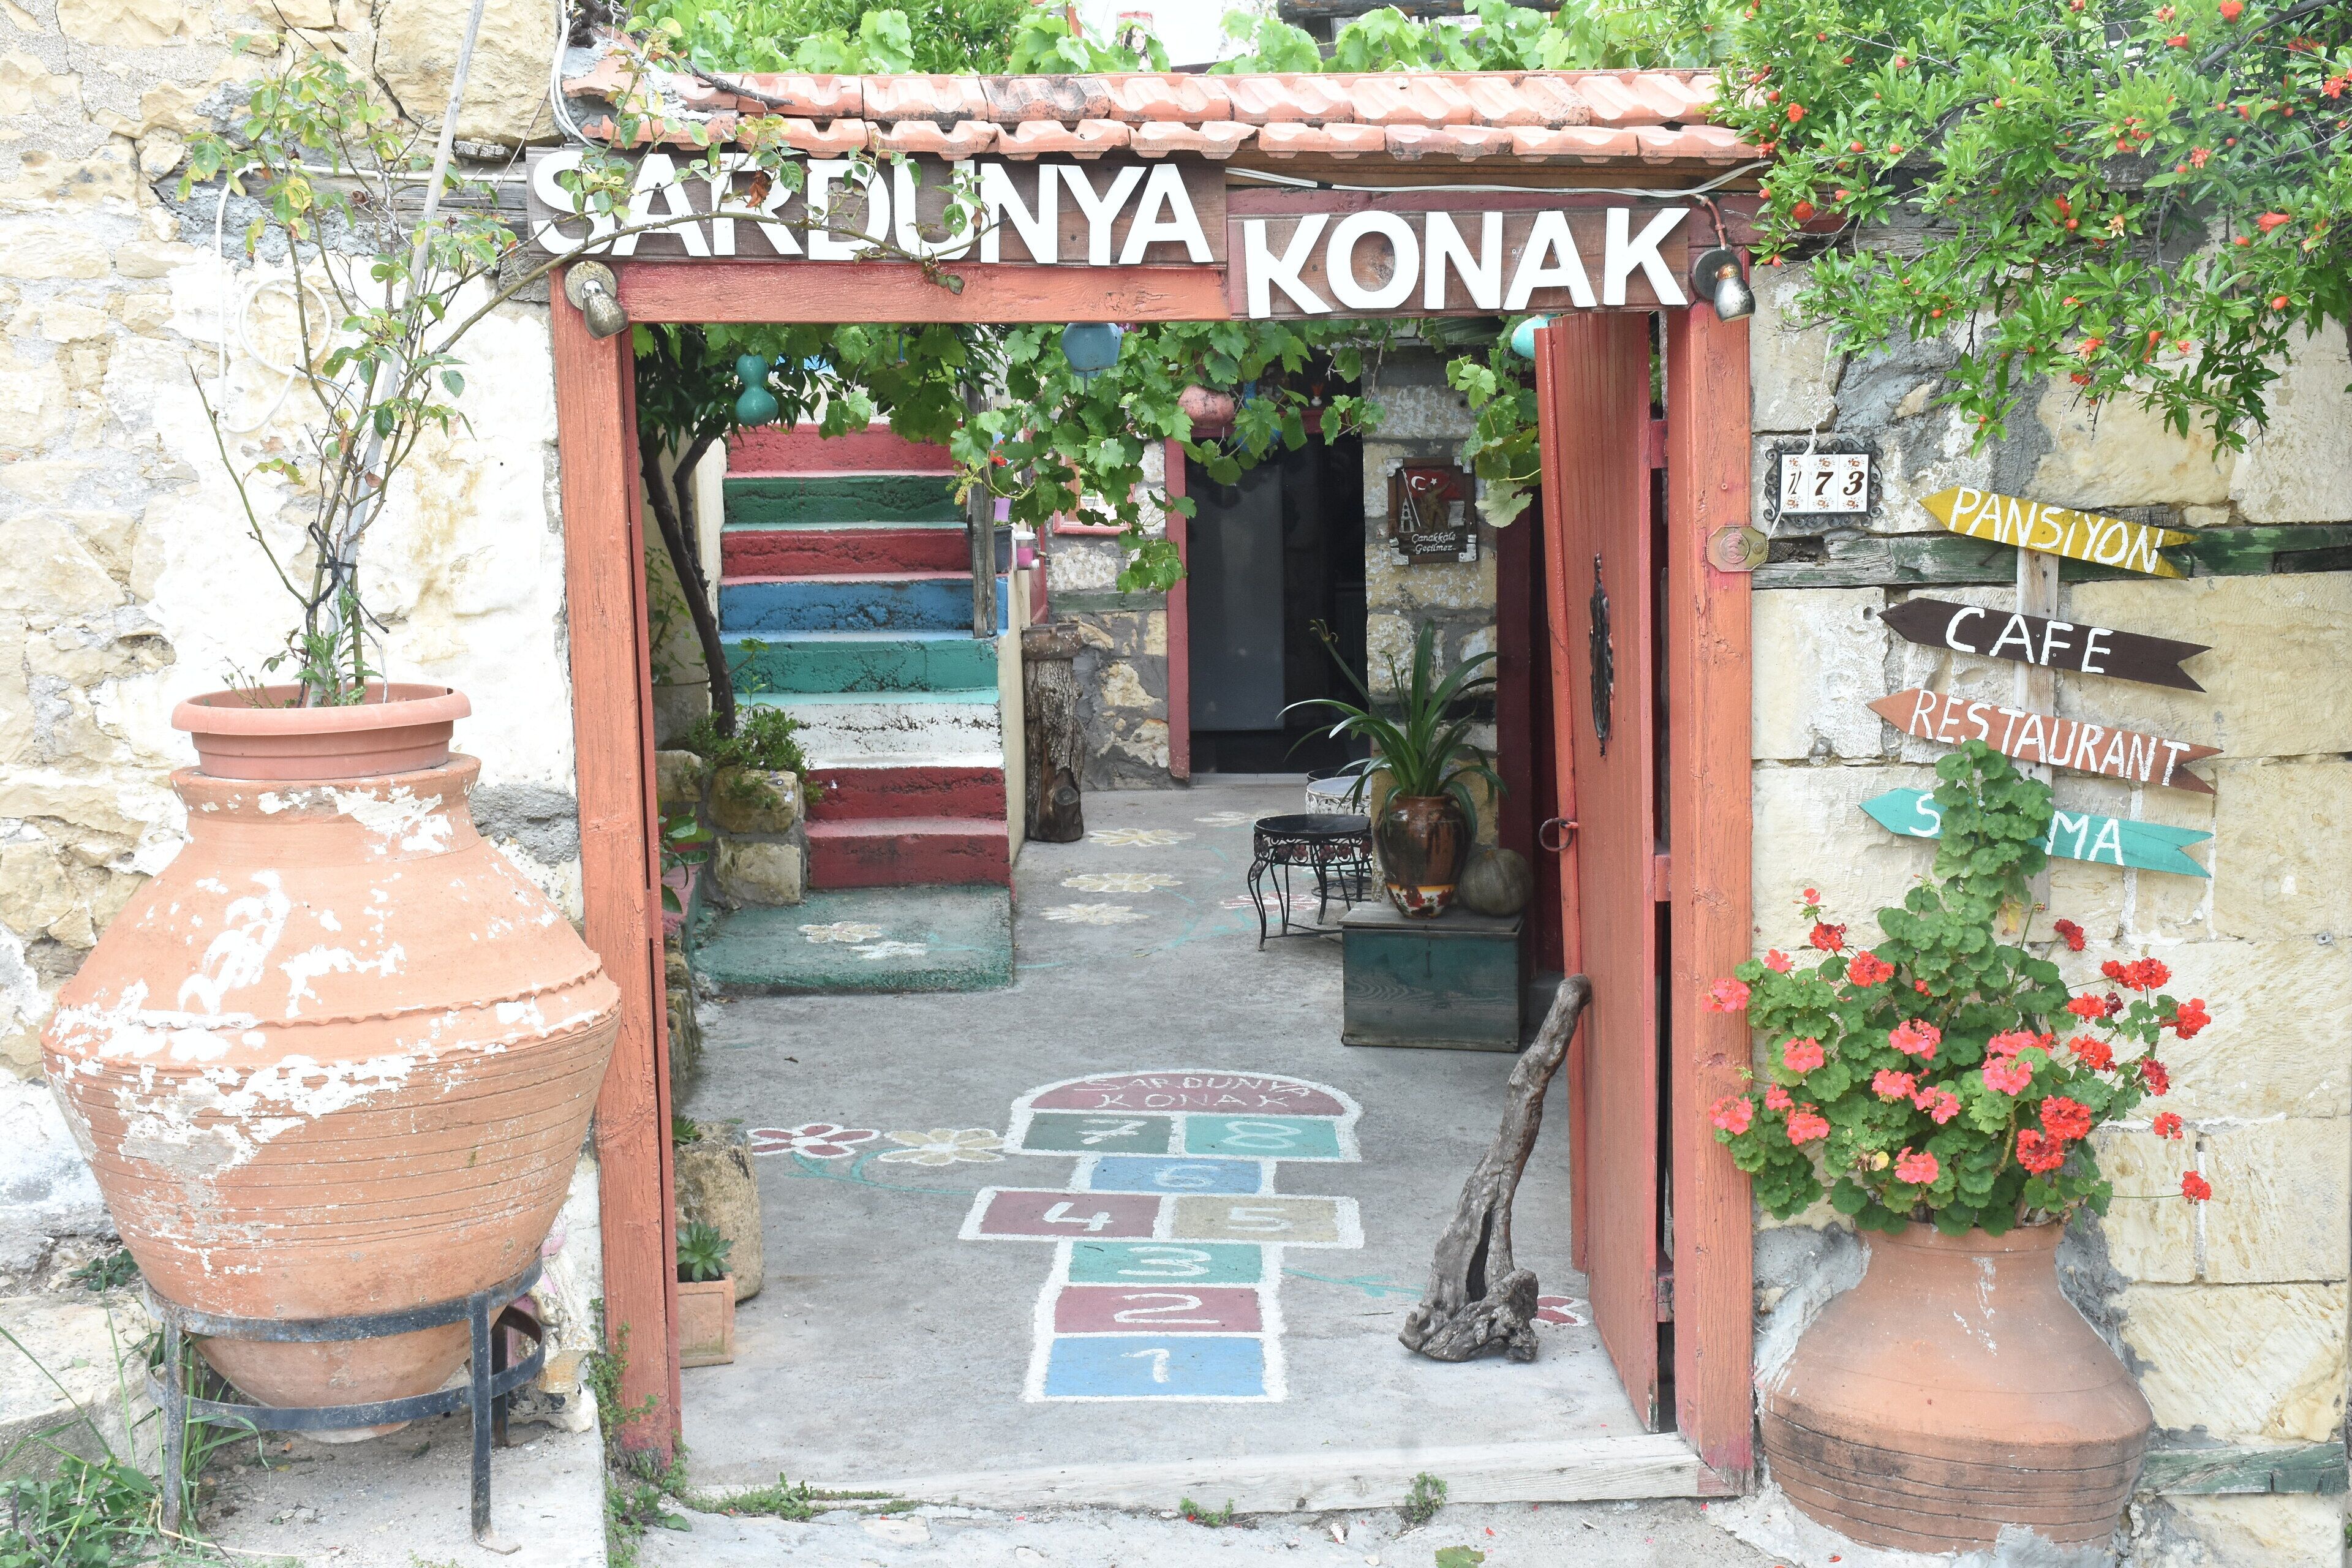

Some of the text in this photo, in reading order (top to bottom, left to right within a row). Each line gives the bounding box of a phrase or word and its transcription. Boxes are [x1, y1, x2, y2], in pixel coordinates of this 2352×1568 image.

[532, 150, 1213, 266] SARDUNYA
[1244, 207, 1691, 319] KONAK
[1788, 470, 1865, 496] 173
[1945, 606, 2114, 674] CAFE
[1909, 689, 2191, 786] RESTAURANT
[1909, 793, 2125, 866] SMA
[1074, 1077, 1310, 1097] SARDUNYA
[1095, 1094, 1289, 1107] KONAK
[1077, 1119, 1147, 1145] 7
[1221, 1121, 1302, 1148] 8
[1154, 1164, 1221, 1188] 6
[1043, 1201, 1114, 1232] 4
[1226, 1207, 1291, 1232] 5
[1117, 1246, 1212, 1276] 3
[1113, 1292, 1219, 1325] 2
[1120, 1348, 1170, 1384] 1
